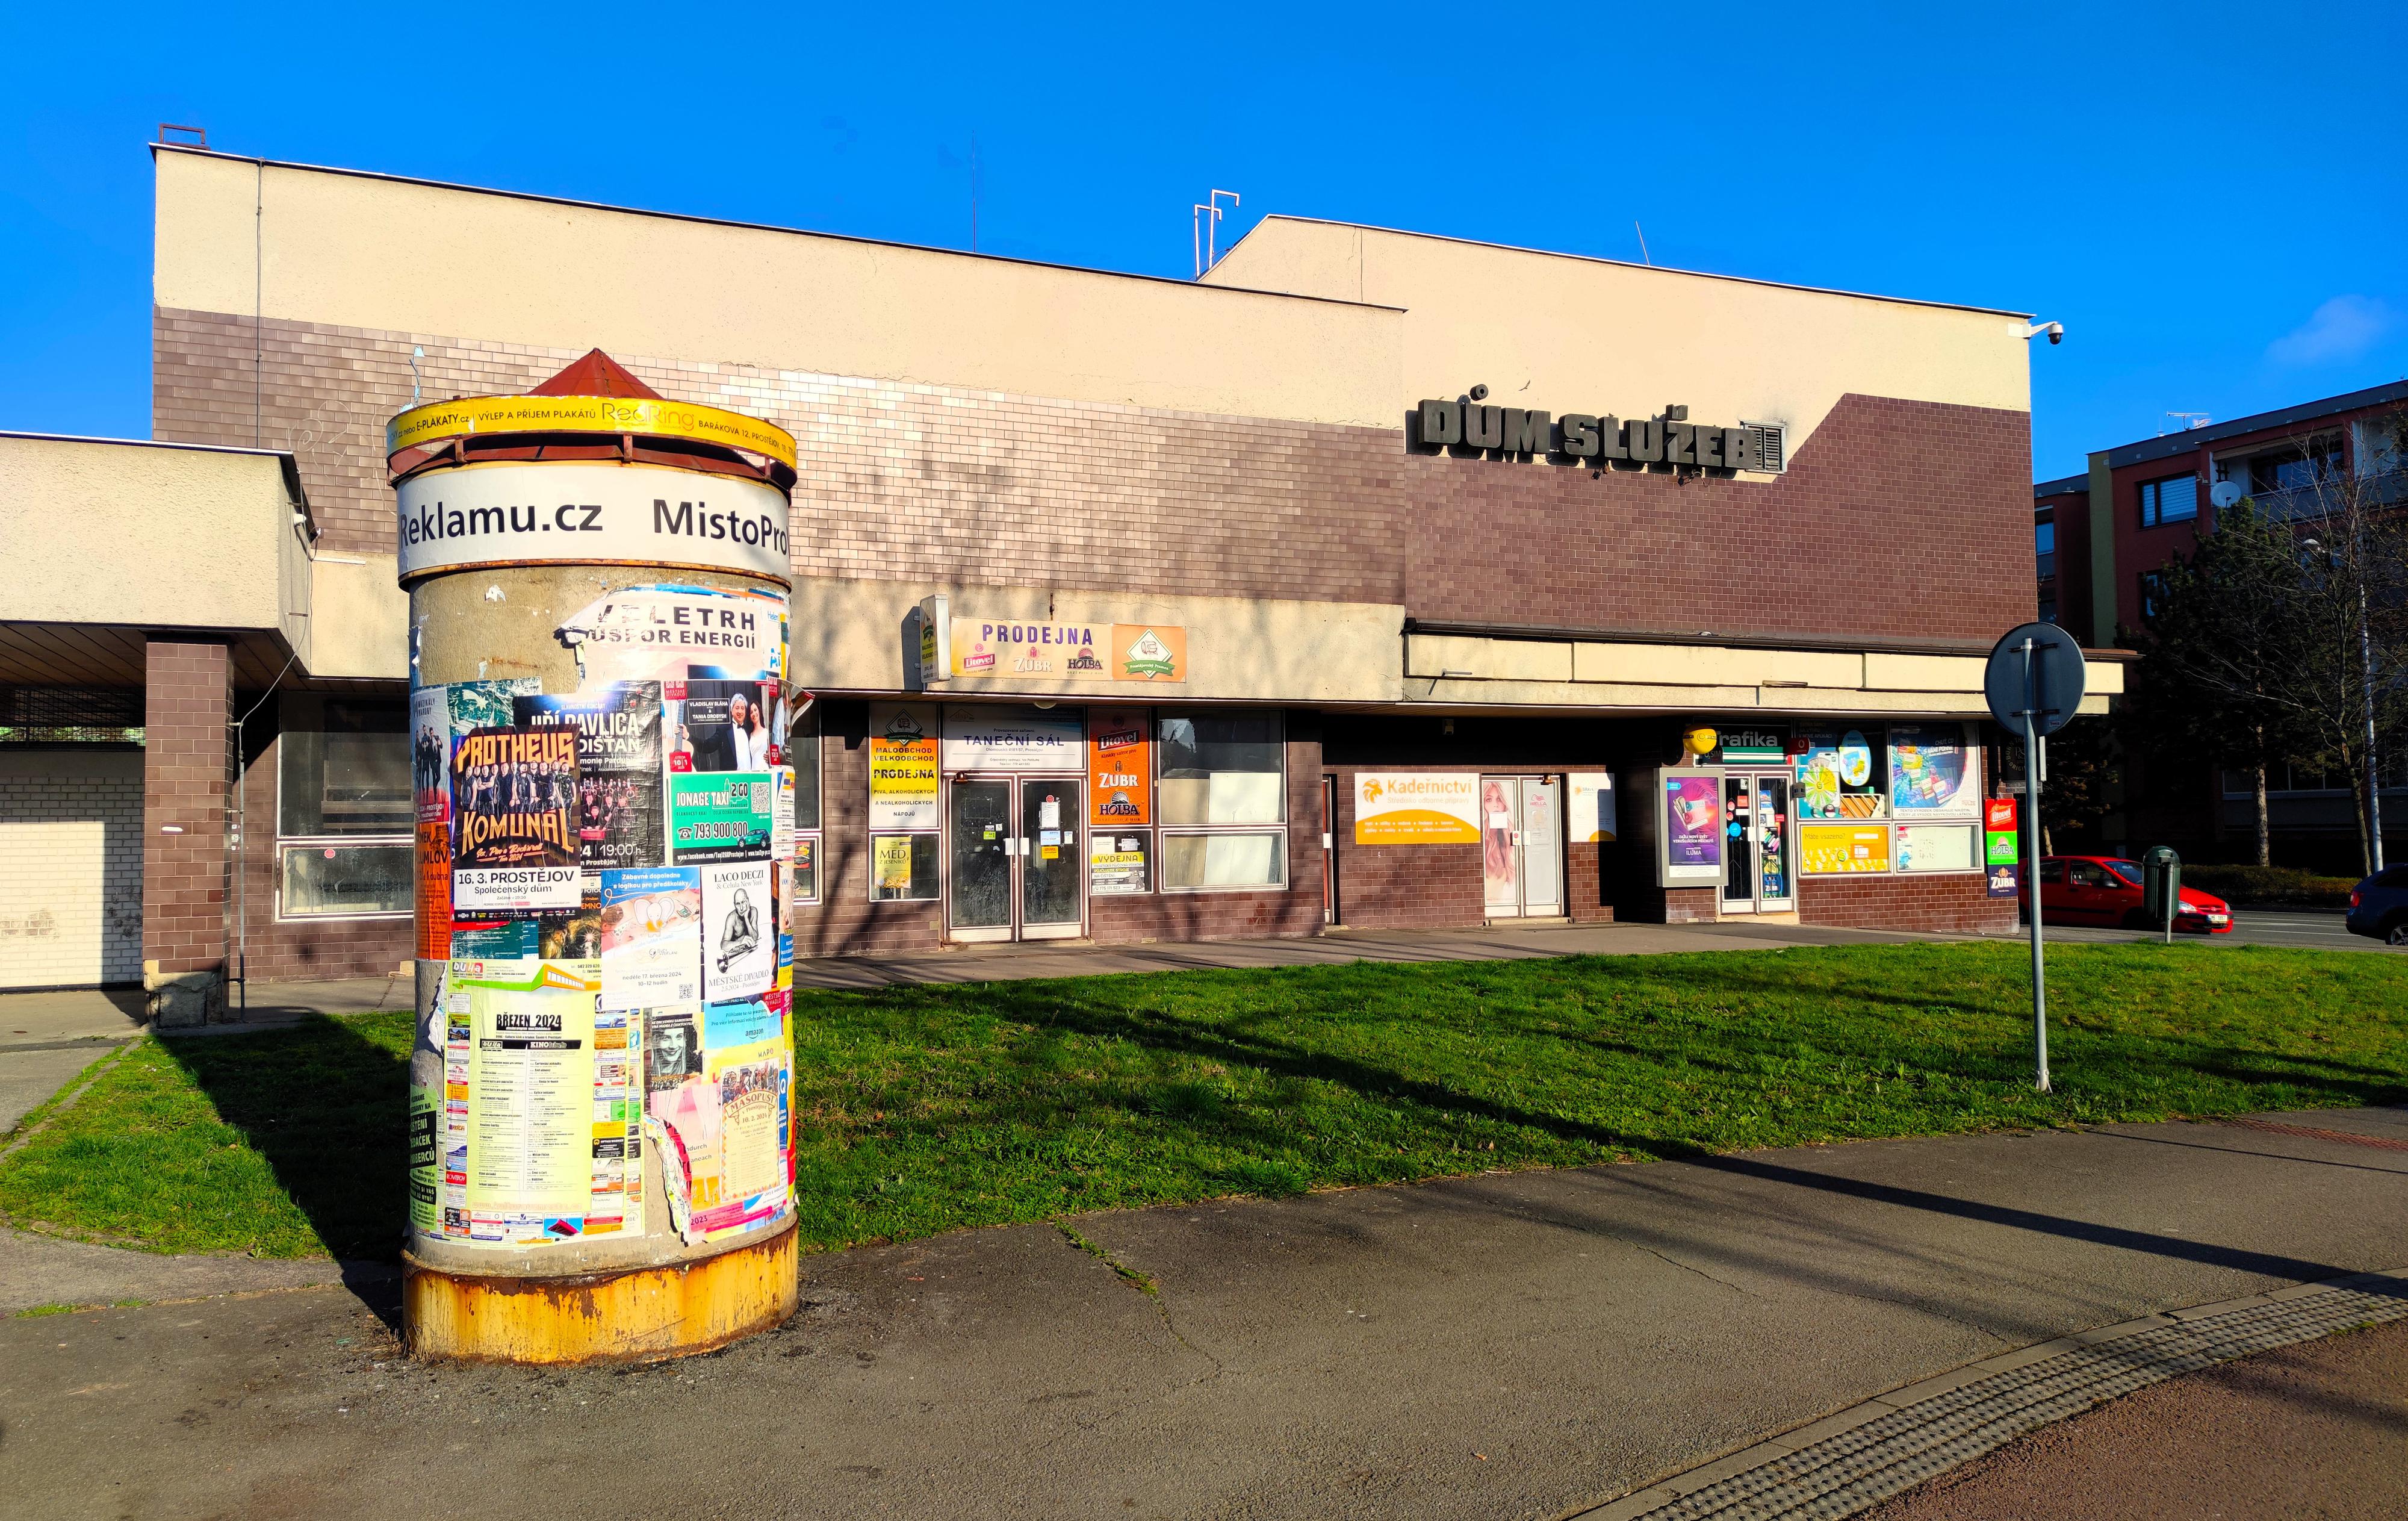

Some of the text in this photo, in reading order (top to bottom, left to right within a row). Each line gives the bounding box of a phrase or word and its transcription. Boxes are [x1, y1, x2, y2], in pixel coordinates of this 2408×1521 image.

[417, 413, 470, 431] E-PLAKATY.cz
[479, 410, 504, 421] VÝLEP
[507, 409, 514, 419] A
[517, 408, 550, 418] PŘÍJEM
[553, 408, 597, 418] PLAKÁTŮ
[601, 403, 695, 431] RedRing
[1418, 384, 1757, 470] DŮM SLUŽEB
[698, 420, 781, 450] BARÁKOVA 12, PROSTĚJOV,
[680, 631, 756, 649] ENERGIÍ
[982, 624, 1093, 645] PRODEJNA
[965, 655, 994, 668] Litovel
[1014, 658, 1053, 673] ZUBR
[1067, 659, 1103, 670] HOLBA
[964, 733, 1064, 746] TANEČNÍ SÁL
[1100, 732, 1137, 749] Litovel
[458, 732, 576, 774] PROTHEUS
[874, 769, 934, 779] PRODEJNA
[1099, 773, 1139, 788] ZUBR
[731, 783, 748, 797] 2 GO
[1387, 778, 1472, 794] Kadeřnictví
[676, 791, 729, 806] JONAGE TAXI
[1099, 804, 1140, 816] HOLBA
[1992, 807, 2011, 823] Litovel
[462, 809, 574, 857] KOMUNÁL
[694, 821, 748, 839] 793 900 800
[600, 844, 633, 856] 19:00
[880, 849, 906, 859] MED
[1990, 845, 2014, 854] HOLBA
[510, 853, 523, 862] 2024
[430, 871, 448, 880] dubna
[459, 873, 474, 885] 16.
[477, 874, 487, 884] 3.
[491, 868, 574, 884] PROSTĚJOV
[649, 872, 681, 880] dopoledne
[714, 869, 763, 883] LACO DECZI
[1991, 876, 2015, 889] ZUBR
[474, 883, 552, 896] Společenský dům
[653, 879, 689, 889] předškoláky
[709, 969, 769, 987] MĚSTSKÉ DIVADLO
[497, 1012, 562, 1027] BŘEZEN 2024
[745, 1028, 763, 1036] amazon
[730, 1092, 775, 1113] MASOPUST
[691, 1215, 708, 1226] 2023
